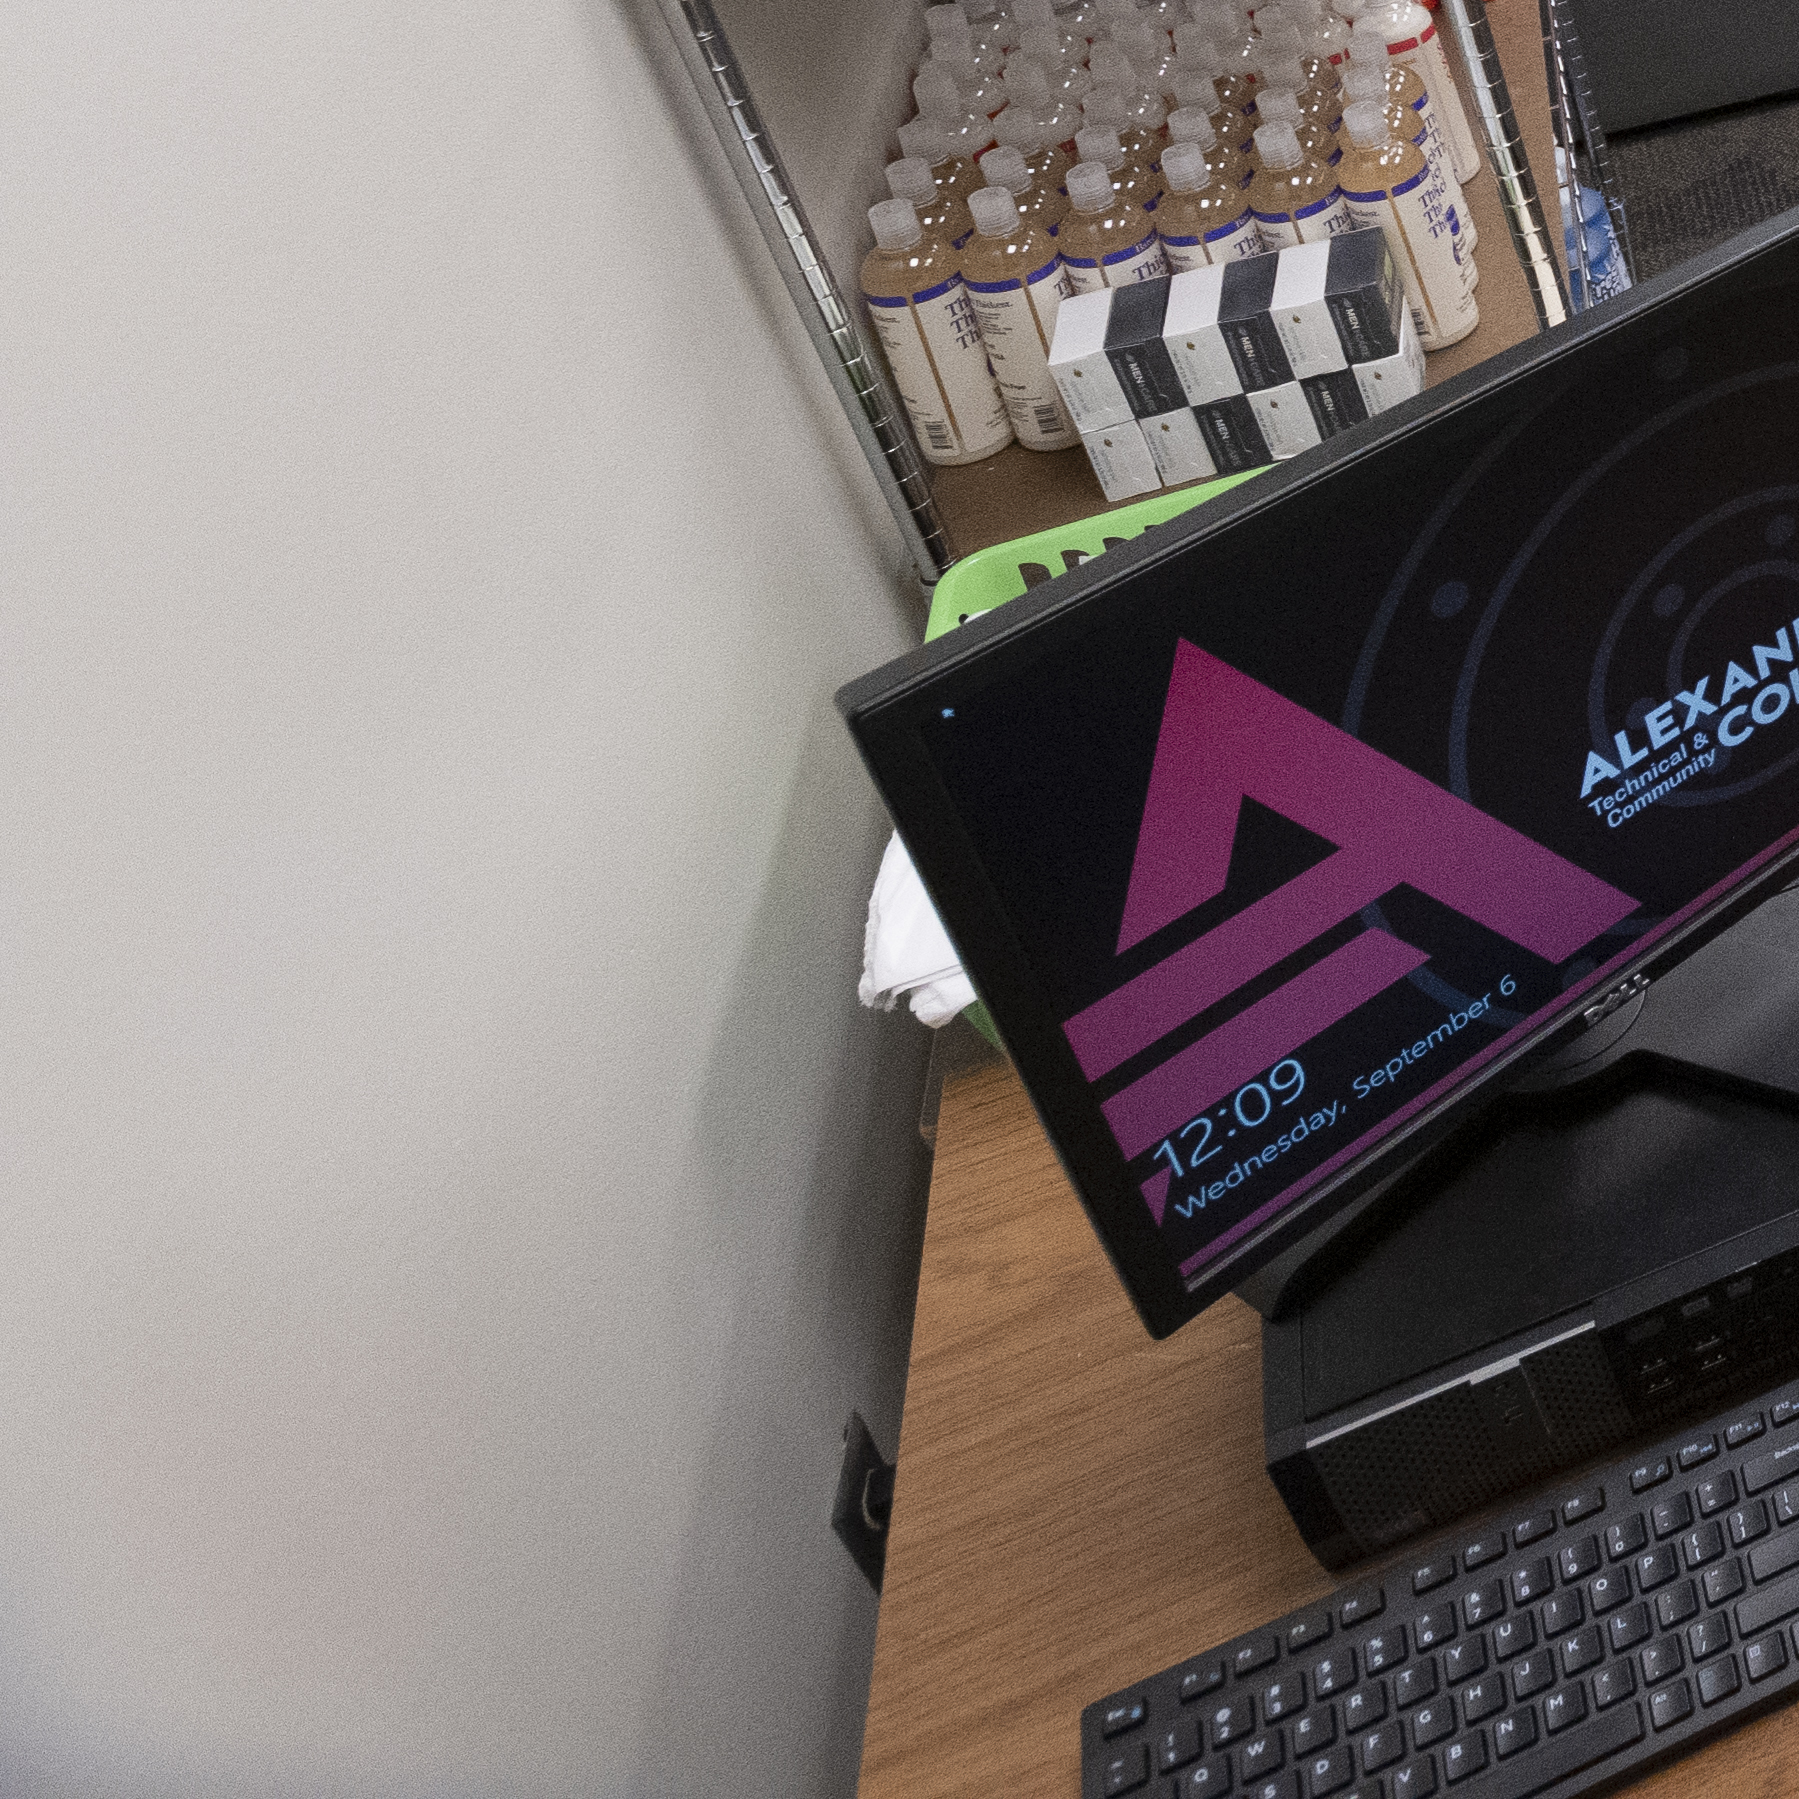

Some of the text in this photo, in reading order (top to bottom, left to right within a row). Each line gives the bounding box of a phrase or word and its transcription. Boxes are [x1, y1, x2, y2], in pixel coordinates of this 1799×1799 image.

[1587, 731, 1709, 817] Technical &
[1606, 747, 1717, 829] Community
[1173, 974, 1517, 1219] Wednesday, September 6
[1152, 1058, 1305, 1179] 12:09
[1643, 1555, 1654, 1569] P
[1500, 1623, 1512, 1637] U
[1450, 1646, 1463, 1660] Y
[1567, 1640, 1580, 1653] K
[1520, 1662, 1531, 1676] J
[1469, 1686, 1482, 1700] H
[1549, 1694, 1564, 1709] M
[1500, 1719, 1514, 1734] N
[1450, 1745, 1463, 1759] B
